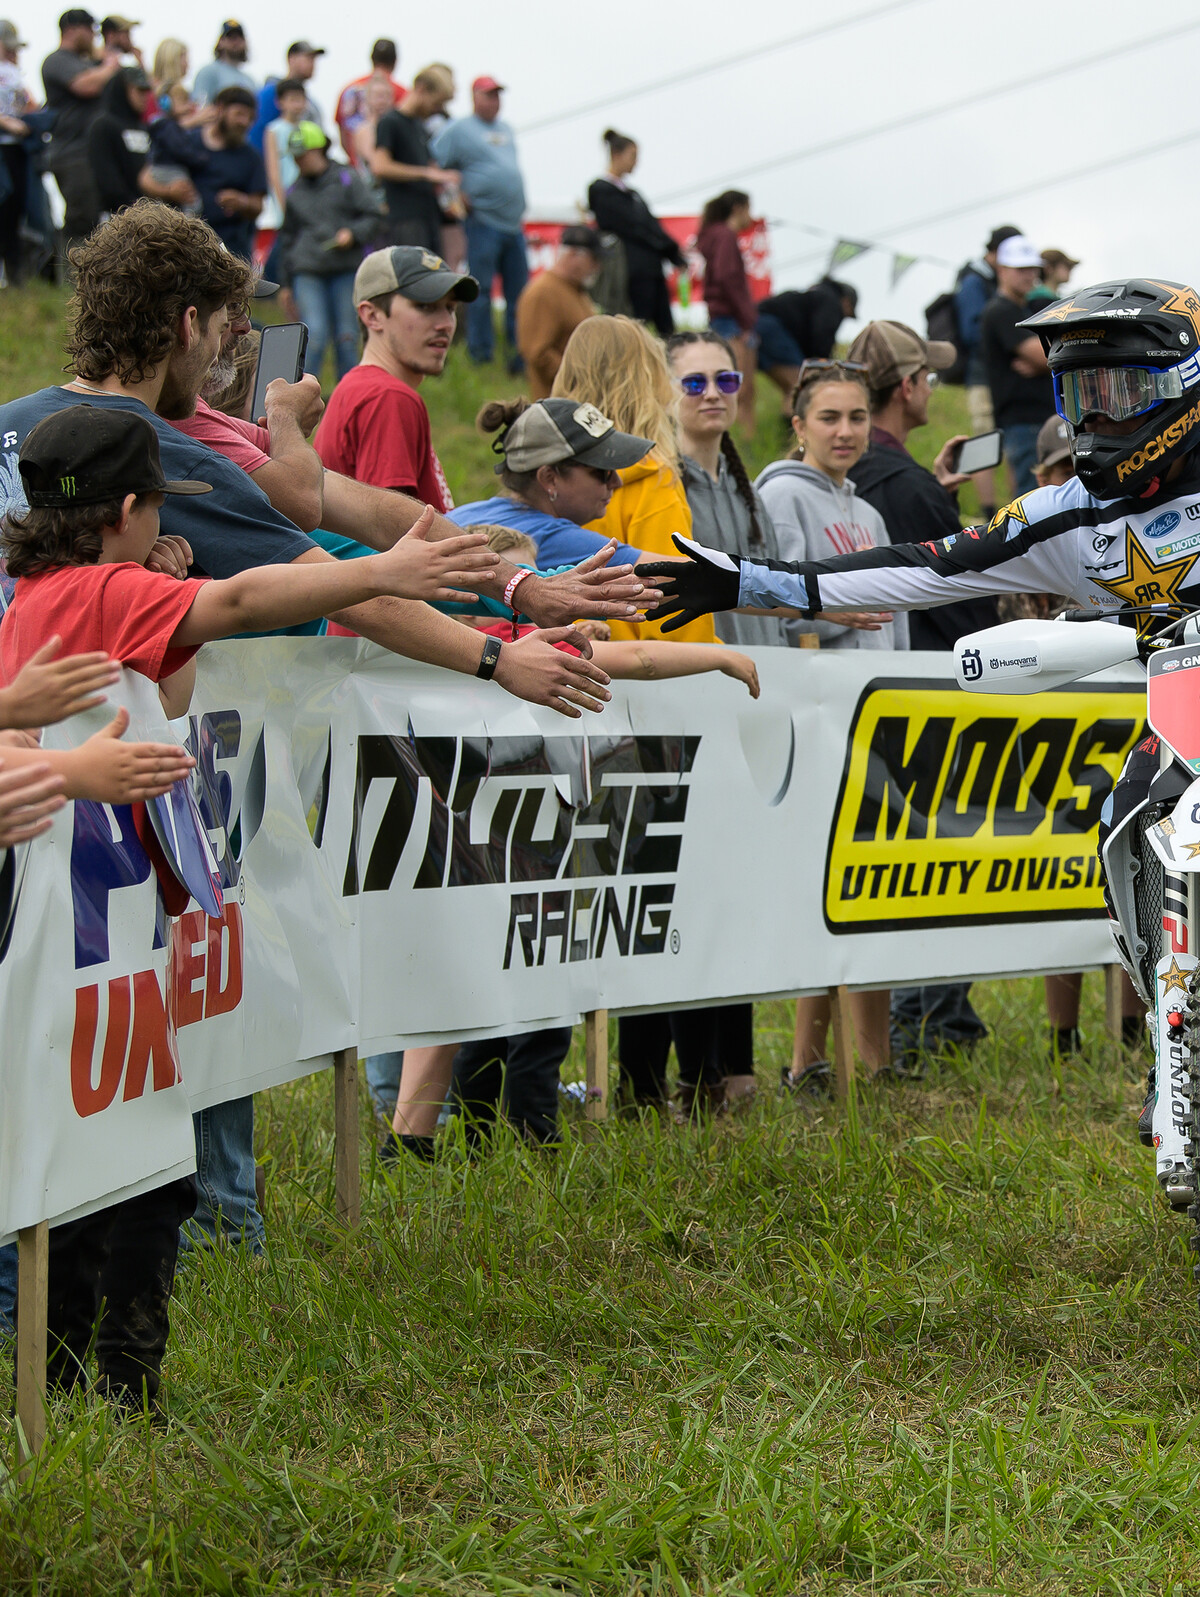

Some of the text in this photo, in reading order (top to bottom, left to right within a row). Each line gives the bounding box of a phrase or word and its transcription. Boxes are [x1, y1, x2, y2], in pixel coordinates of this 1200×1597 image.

[1000, 656, 1037, 667] Husqvarna
[852, 716, 1141, 842] MOOS
[839, 855, 1107, 901] UTILITY DIVISI
[503, 883, 676, 970] RACING
